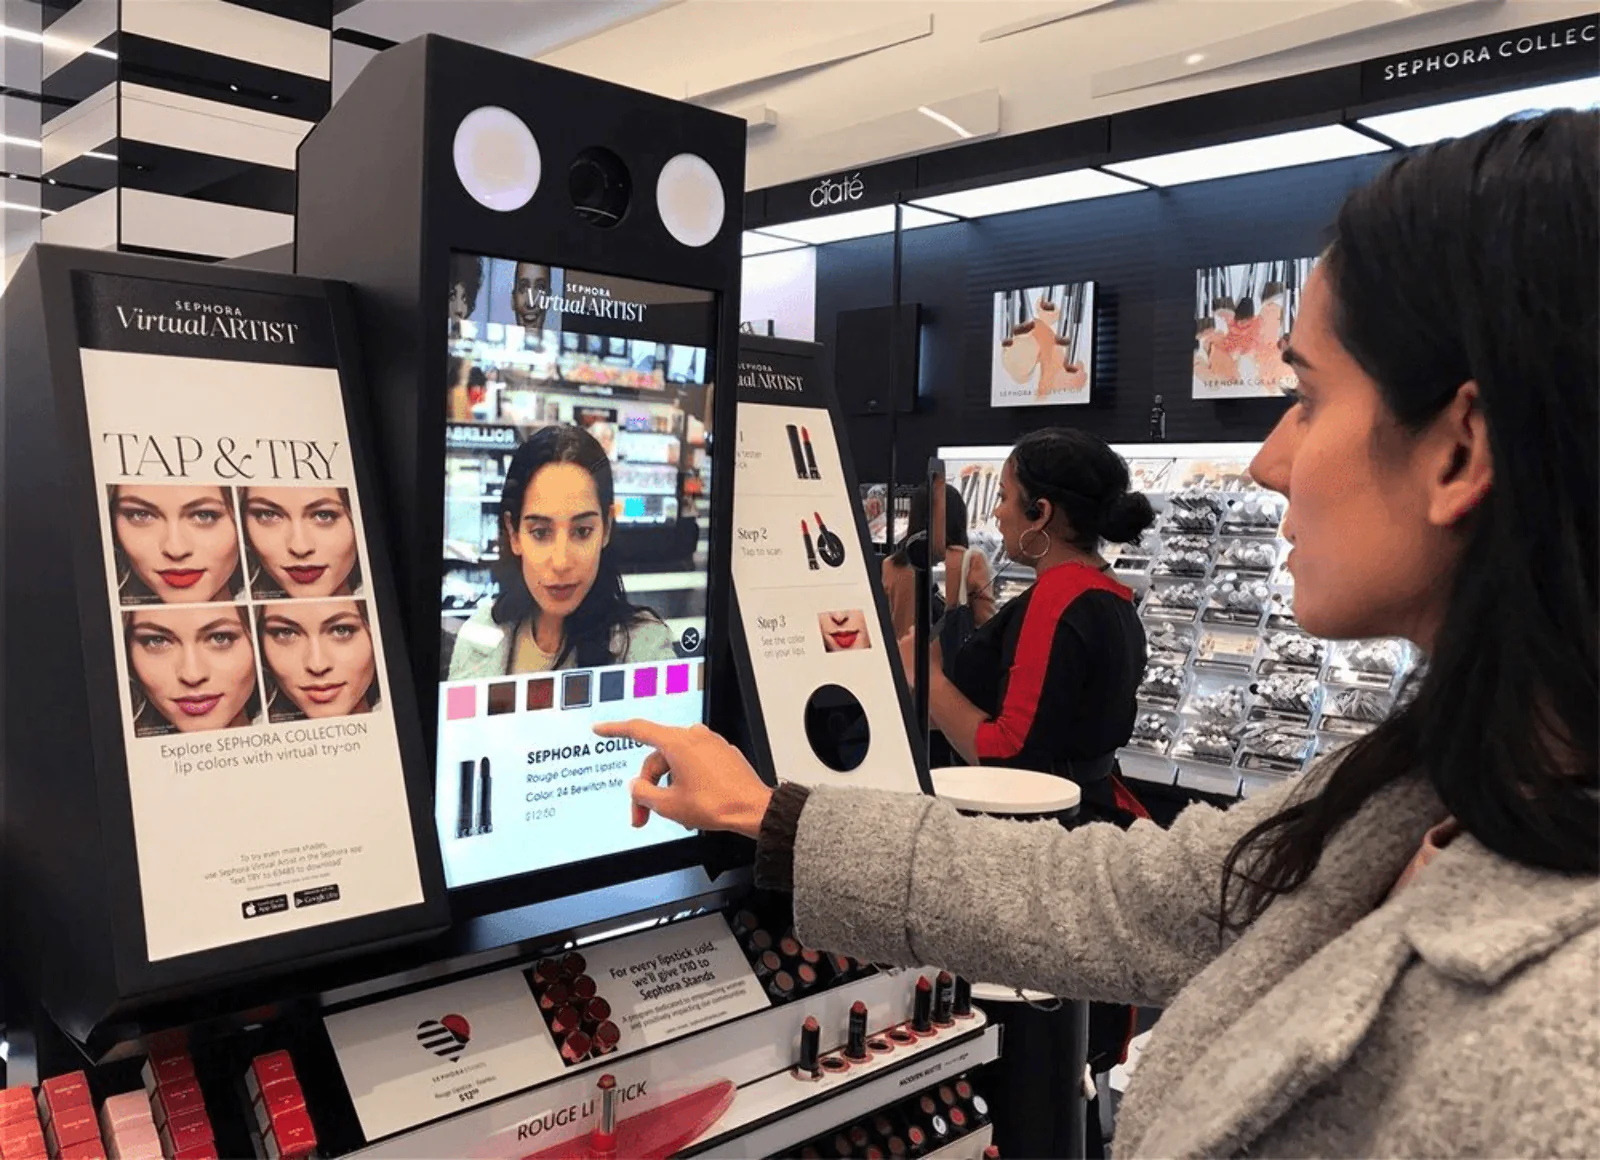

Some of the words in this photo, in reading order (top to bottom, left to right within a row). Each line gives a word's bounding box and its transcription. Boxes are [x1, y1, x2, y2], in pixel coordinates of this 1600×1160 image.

[1384, 46, 1491, 81] SEPHORA
[1499, 24, 1596, 57] COLLEC
[527, 287, 586, 316] Virtual
[587, 297, 648, 323] ARTIST
[566, 283, 611, 298] SEPHORA
[175, 300, 243, 316] SEPHORA
[116, 305, 208, 336] Virtual
[209, 316, 299, 345] ARTIST
[757, 372, 804, 392] ARTIST
[103, 432, 203, 477] TAP
[213, 436, 255, 479] &
[255, 438, 340, 480] TRY
[737, 528, 760, 542] Step
[761, 527, 768, 540] 2
[757, 615, 778, 632] Step
[778, 614, 786, 628] 3
[160, 743, 213, 759] Explore
[216, 735, 281, 752] SEPHORA
[284, 722, 368, 744] COLLECTION
[527, 743, 591, 765] SEPHORA
[174, 760, 193, 776] lip
[197, 755, 239, 771] colors
[243, 750, 274, 766] with
[276, 744, 318, 761] virtual
[321, 741, 361, 758] try-on
[526, 771, 559, 784] Rouge
[561, 765, 593, 778] Cream
[595, 760, 628, 772] Lipstick
[570, 781, 607, 795] Bewitch
[609, 778, 624, 788] Me
[609, 967, 628, 980] For
[629, 958, 658, 975] every
[657, 947, 693, 968] lipstick
[632, 973, 656, 989] we'll
[656, 969, 679, 983] give
[679, 962, 697, 974] $10
[697, 958, 710, 968] to
[639, 982, 684, 1000] Sephora
[682, 970, 716, 988] Stands
[517, 1105, 577, 1141] ROUGE
[581, 1081, 647, 1118] LIICK
